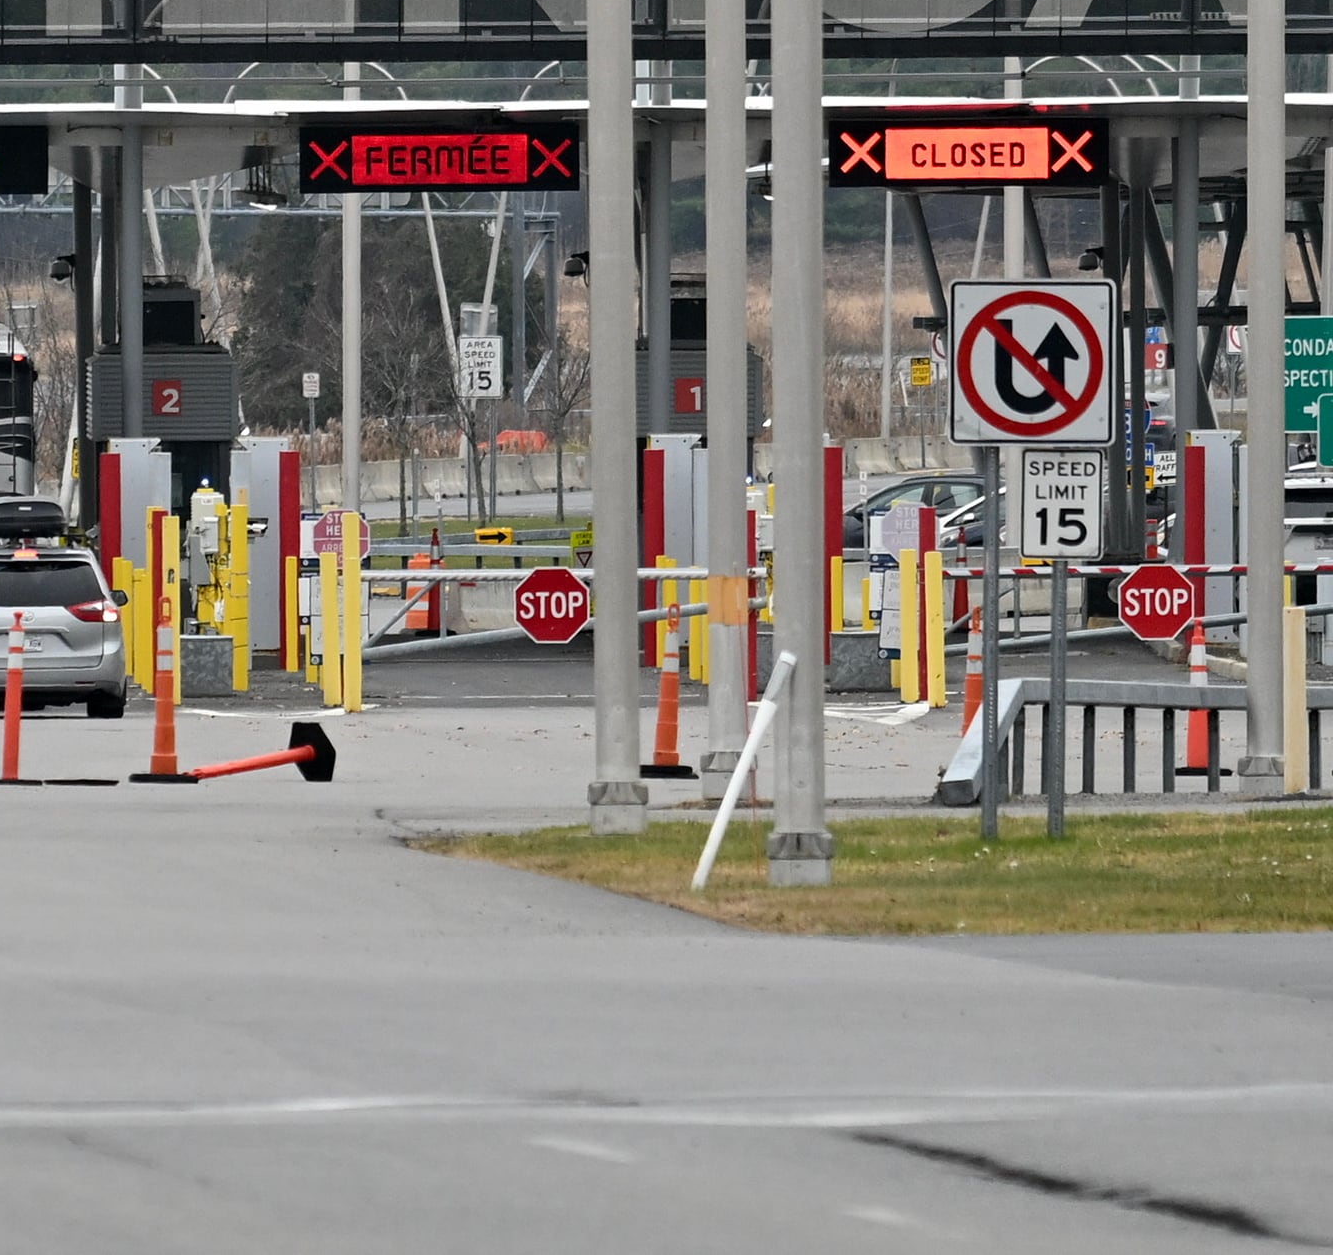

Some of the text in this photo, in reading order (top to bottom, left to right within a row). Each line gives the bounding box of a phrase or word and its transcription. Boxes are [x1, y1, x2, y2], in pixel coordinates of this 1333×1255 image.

[365, 136, 510, 177] FERMÉE
[911, 142, 1027, 168] CLOSED
[464, 351, 495, 359] SPEED
[1154, 349, 1166, 369] 9
[469, 370, 492, 391] 15
[161, 388, 180, 413] 2
[690, 387, 702, 411] 1
[1028, 461, 1097, 477] SPEED
[1154, 464, 1176, 472] RAFF
[1035, 485, 1088, 501] LIMIT
[896, 507, 918, 518] STO
[895, 519, 919, 530] HER
[1035, 507, 1088, 546] 15
[520, 591, 584, 621] STOP
[1124, 588, 1190, 616] STOP
